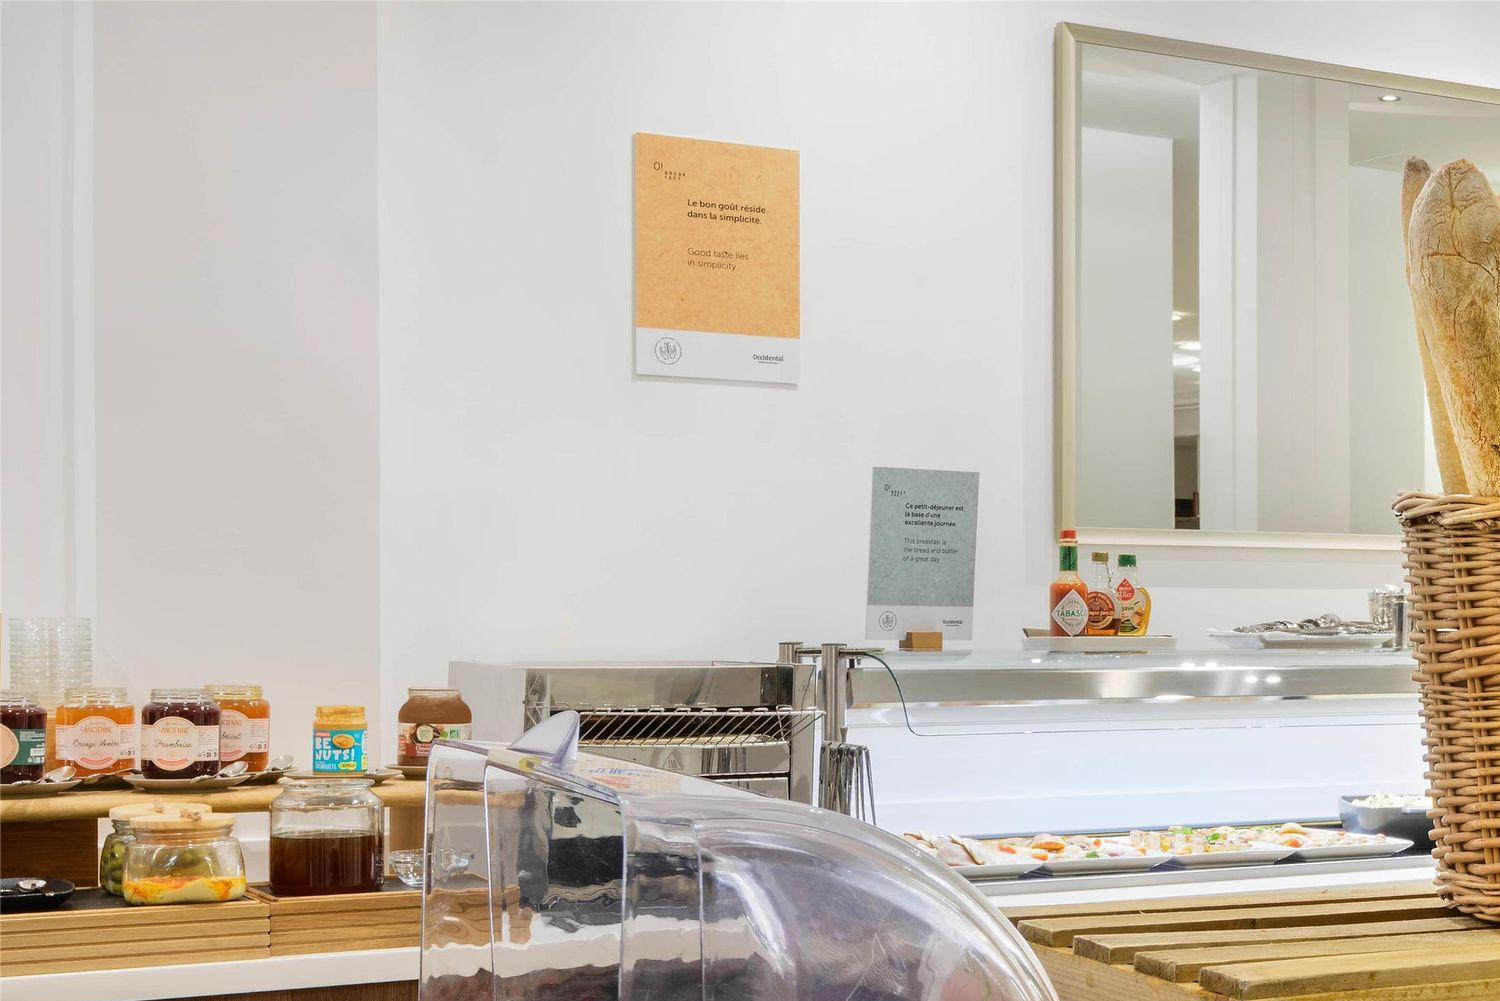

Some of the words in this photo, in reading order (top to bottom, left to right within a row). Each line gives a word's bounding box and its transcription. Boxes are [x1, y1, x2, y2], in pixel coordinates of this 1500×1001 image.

[687, 199, 698, 207] Le
[699, 200, 717, 209] bon
[718, 202, 739, 211] goût
[740, 205, 766, 214] réside
[687, 210, 708, 220] dans
[709, 212, 718, 220] la
[719, 214, 763, 225] simplicité.
[687, 247, 712, 257] Good
[713, 250, 734, 260] taste
[735, 252, 750, 261] lies
[687, 259, 696, 267] in
[697, 260, 737, 271] simplicity
[752, 354, 784, 362] Occidental
[933, 520, 956, 528] journée
[916, 538, 941, 546] breakfast
[154, 739, 193, 749] Framboise
[315, 737, 332, 749] BE
